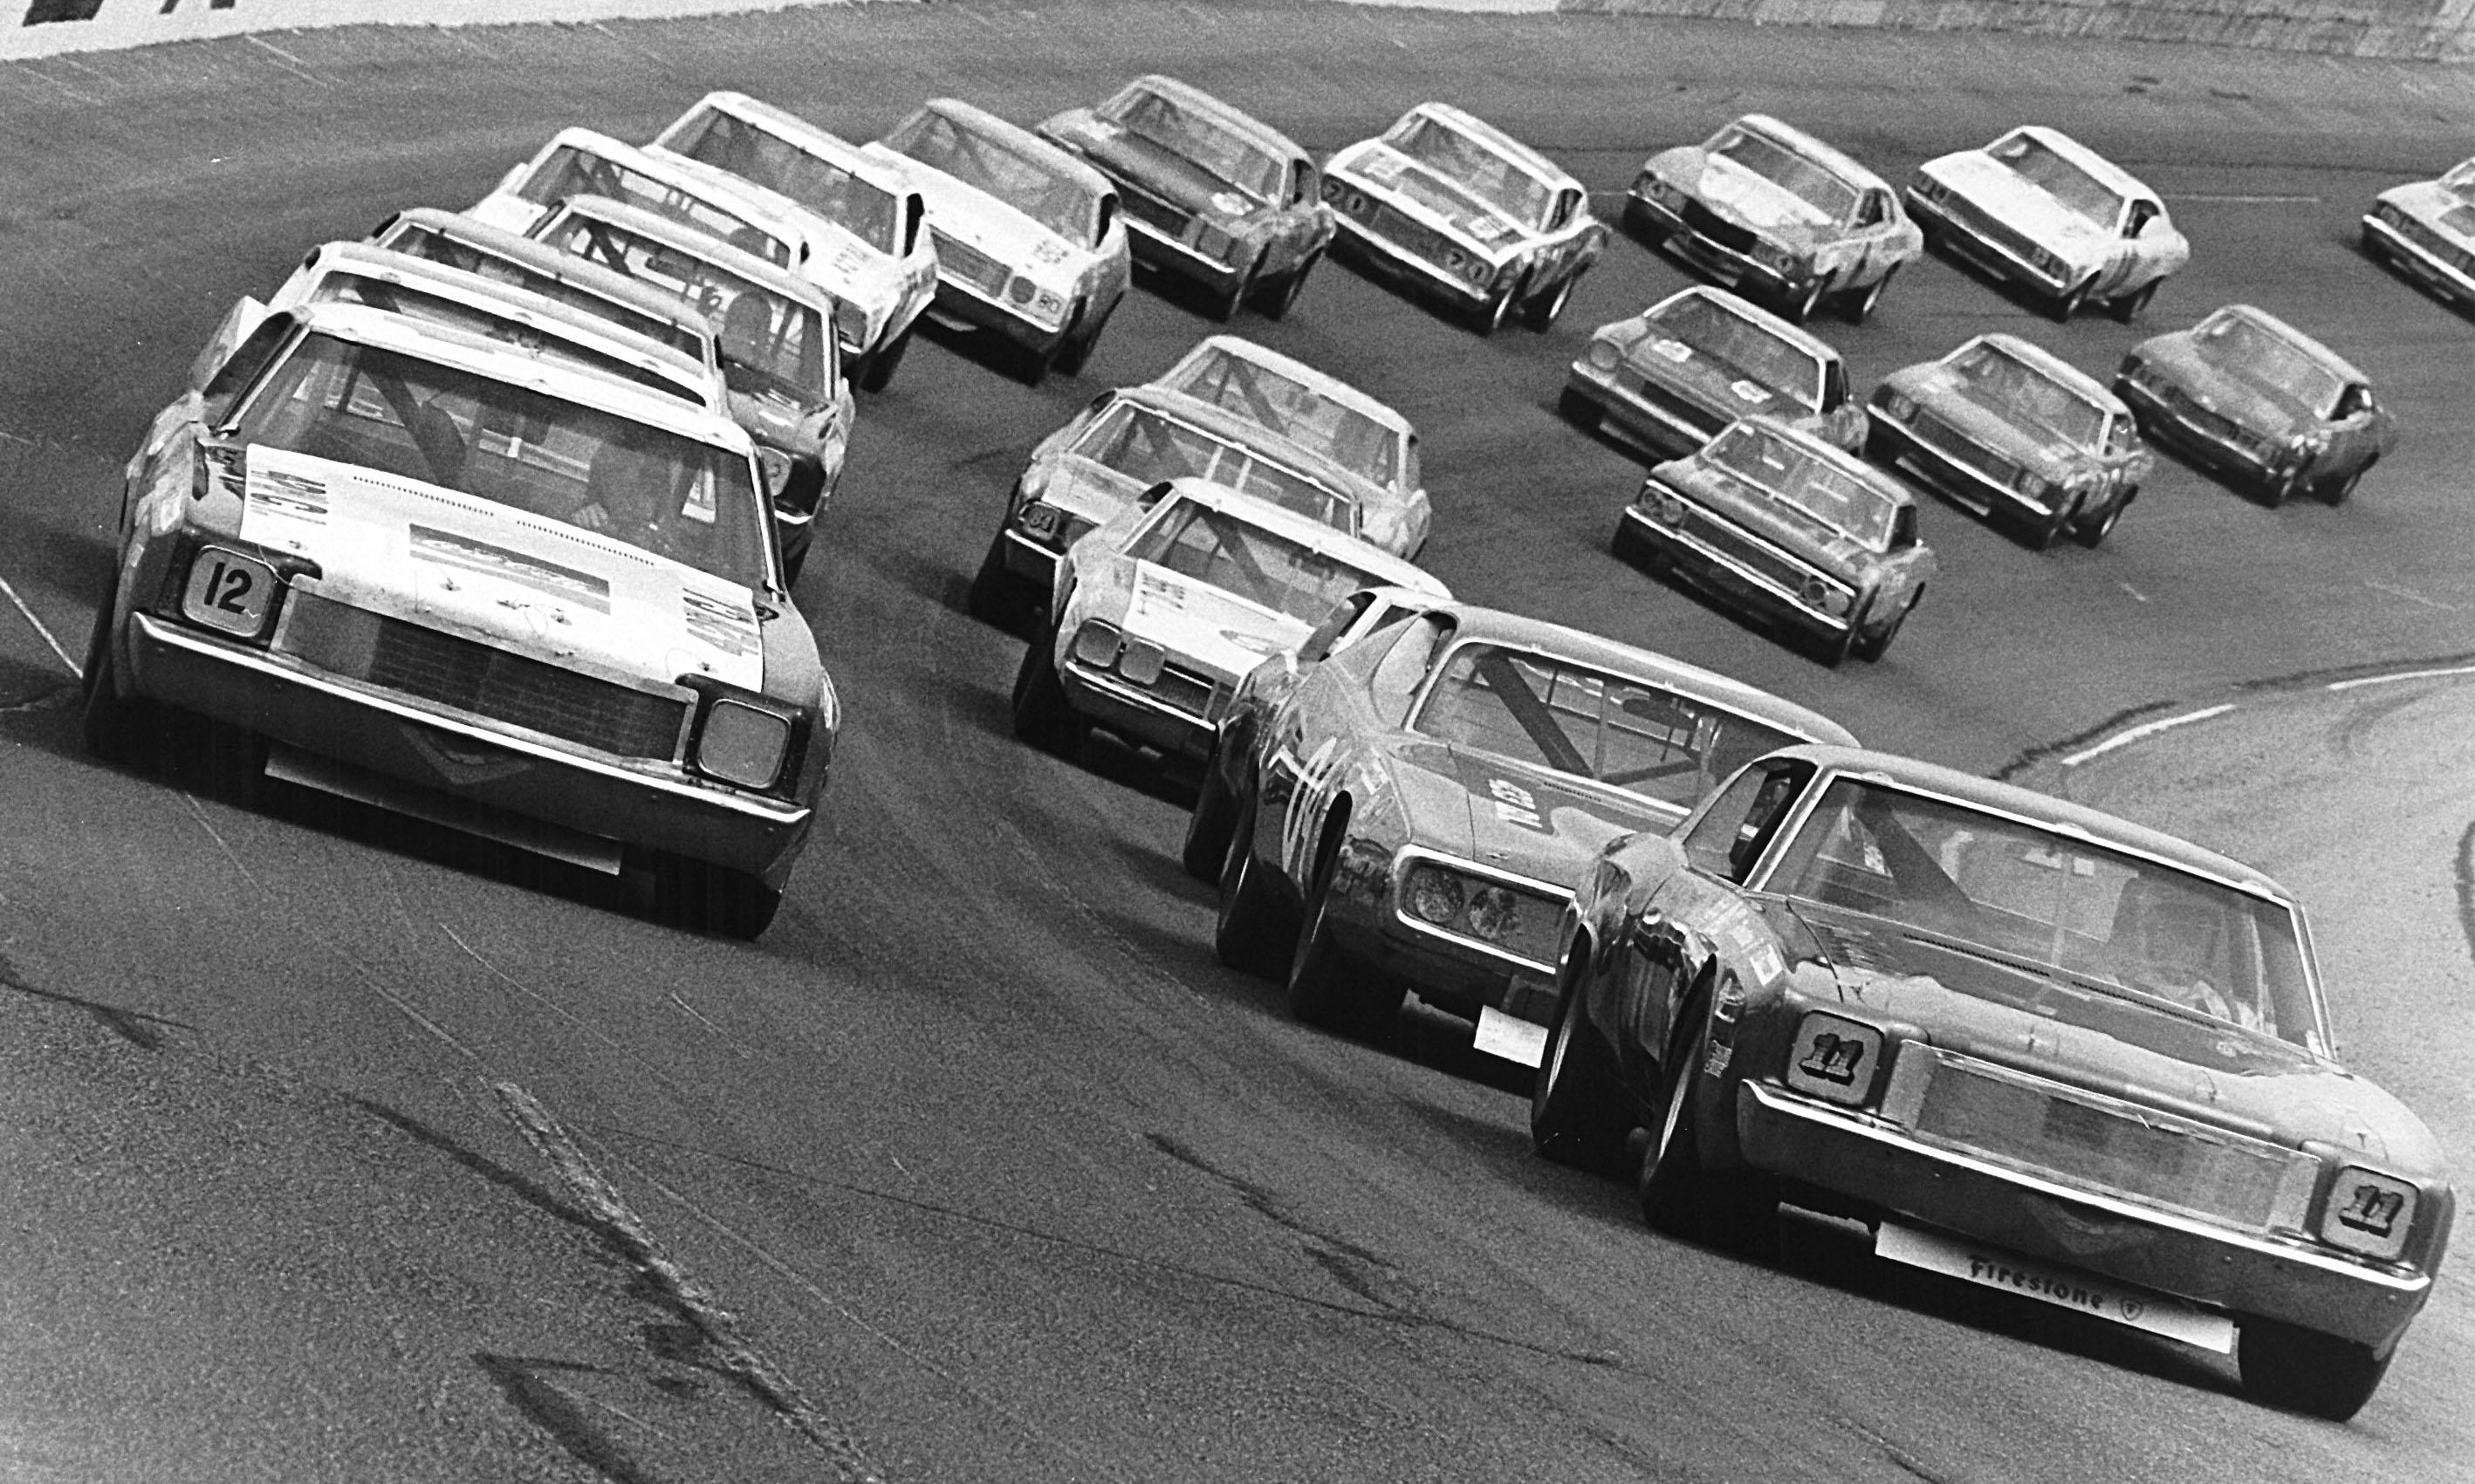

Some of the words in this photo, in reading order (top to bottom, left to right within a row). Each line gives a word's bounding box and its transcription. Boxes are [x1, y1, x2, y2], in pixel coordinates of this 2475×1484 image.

[203, 561, 253, 615] 12
[1799, 1032, 1865, 1087] 11
[2338, 1185, 2404, 1239] 11
[1965, 1254, 2105, 1310] Firestone
